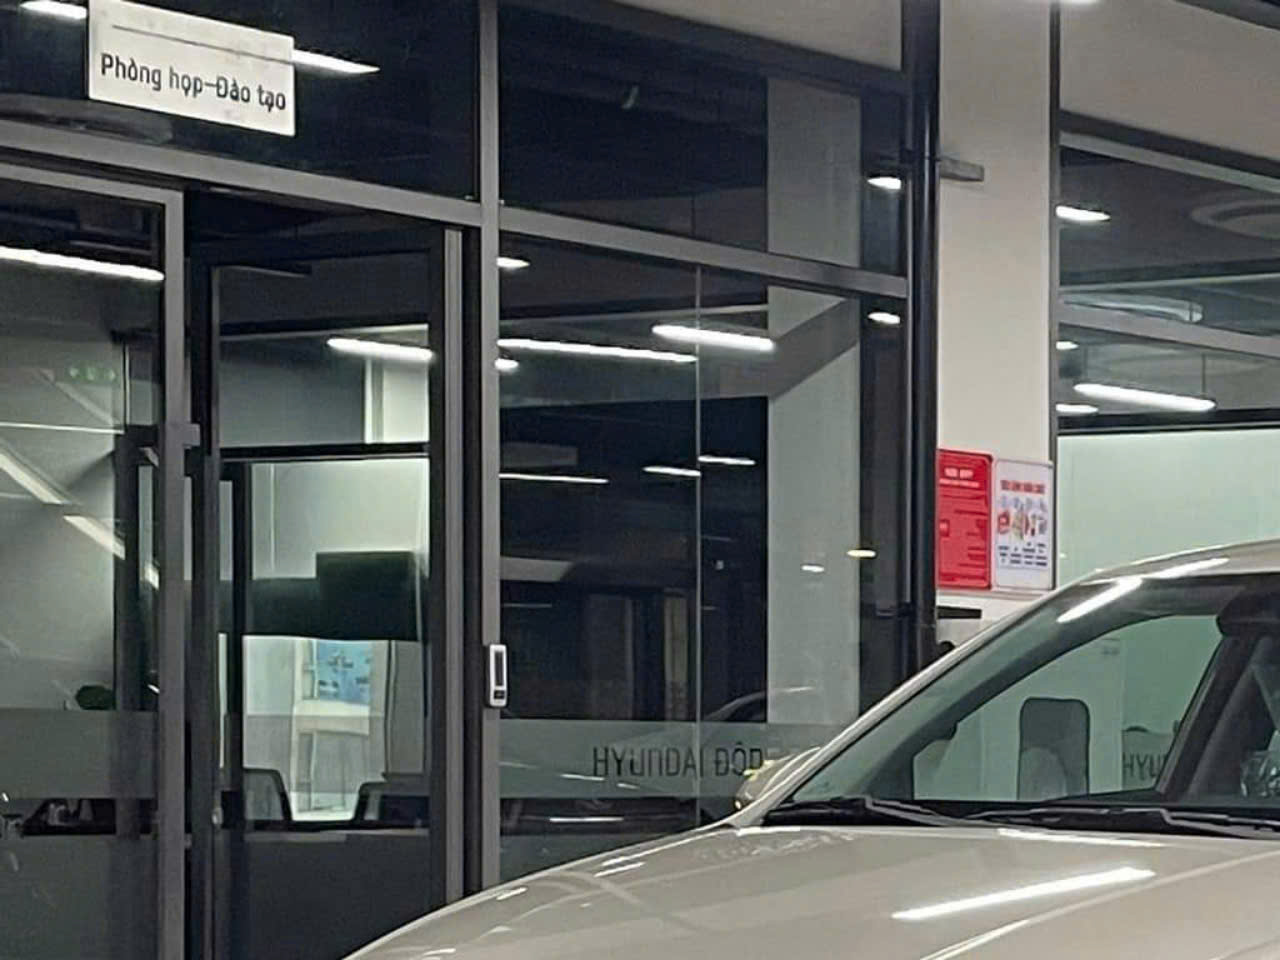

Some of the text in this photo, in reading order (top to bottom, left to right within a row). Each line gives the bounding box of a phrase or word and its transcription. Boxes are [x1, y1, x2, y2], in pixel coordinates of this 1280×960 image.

[101, 53, 162, 91] Phòng
[257, 85, 286, 112] tạo
[592, 747, 705, 777] HYUNDAI
